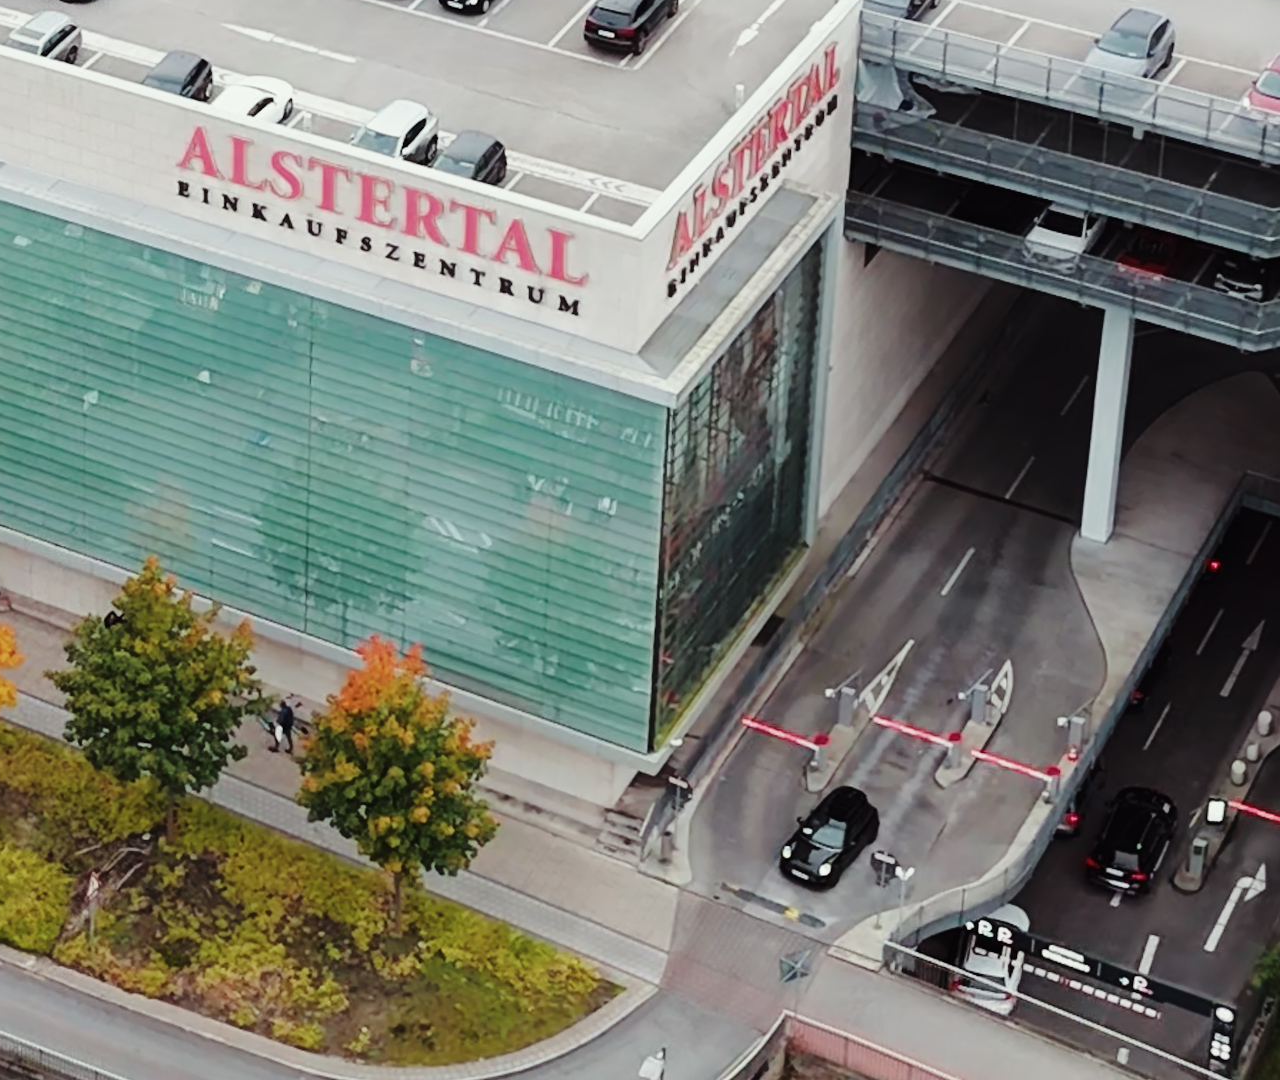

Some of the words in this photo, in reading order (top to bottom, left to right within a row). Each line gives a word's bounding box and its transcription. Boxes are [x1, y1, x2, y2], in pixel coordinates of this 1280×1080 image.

[177, 125, 589, 287] ALSTERTAL
[666, 41, 841, 271] ALSTERTAL
[177, 180, 581, 317] EINKAUFSZENTRUM
